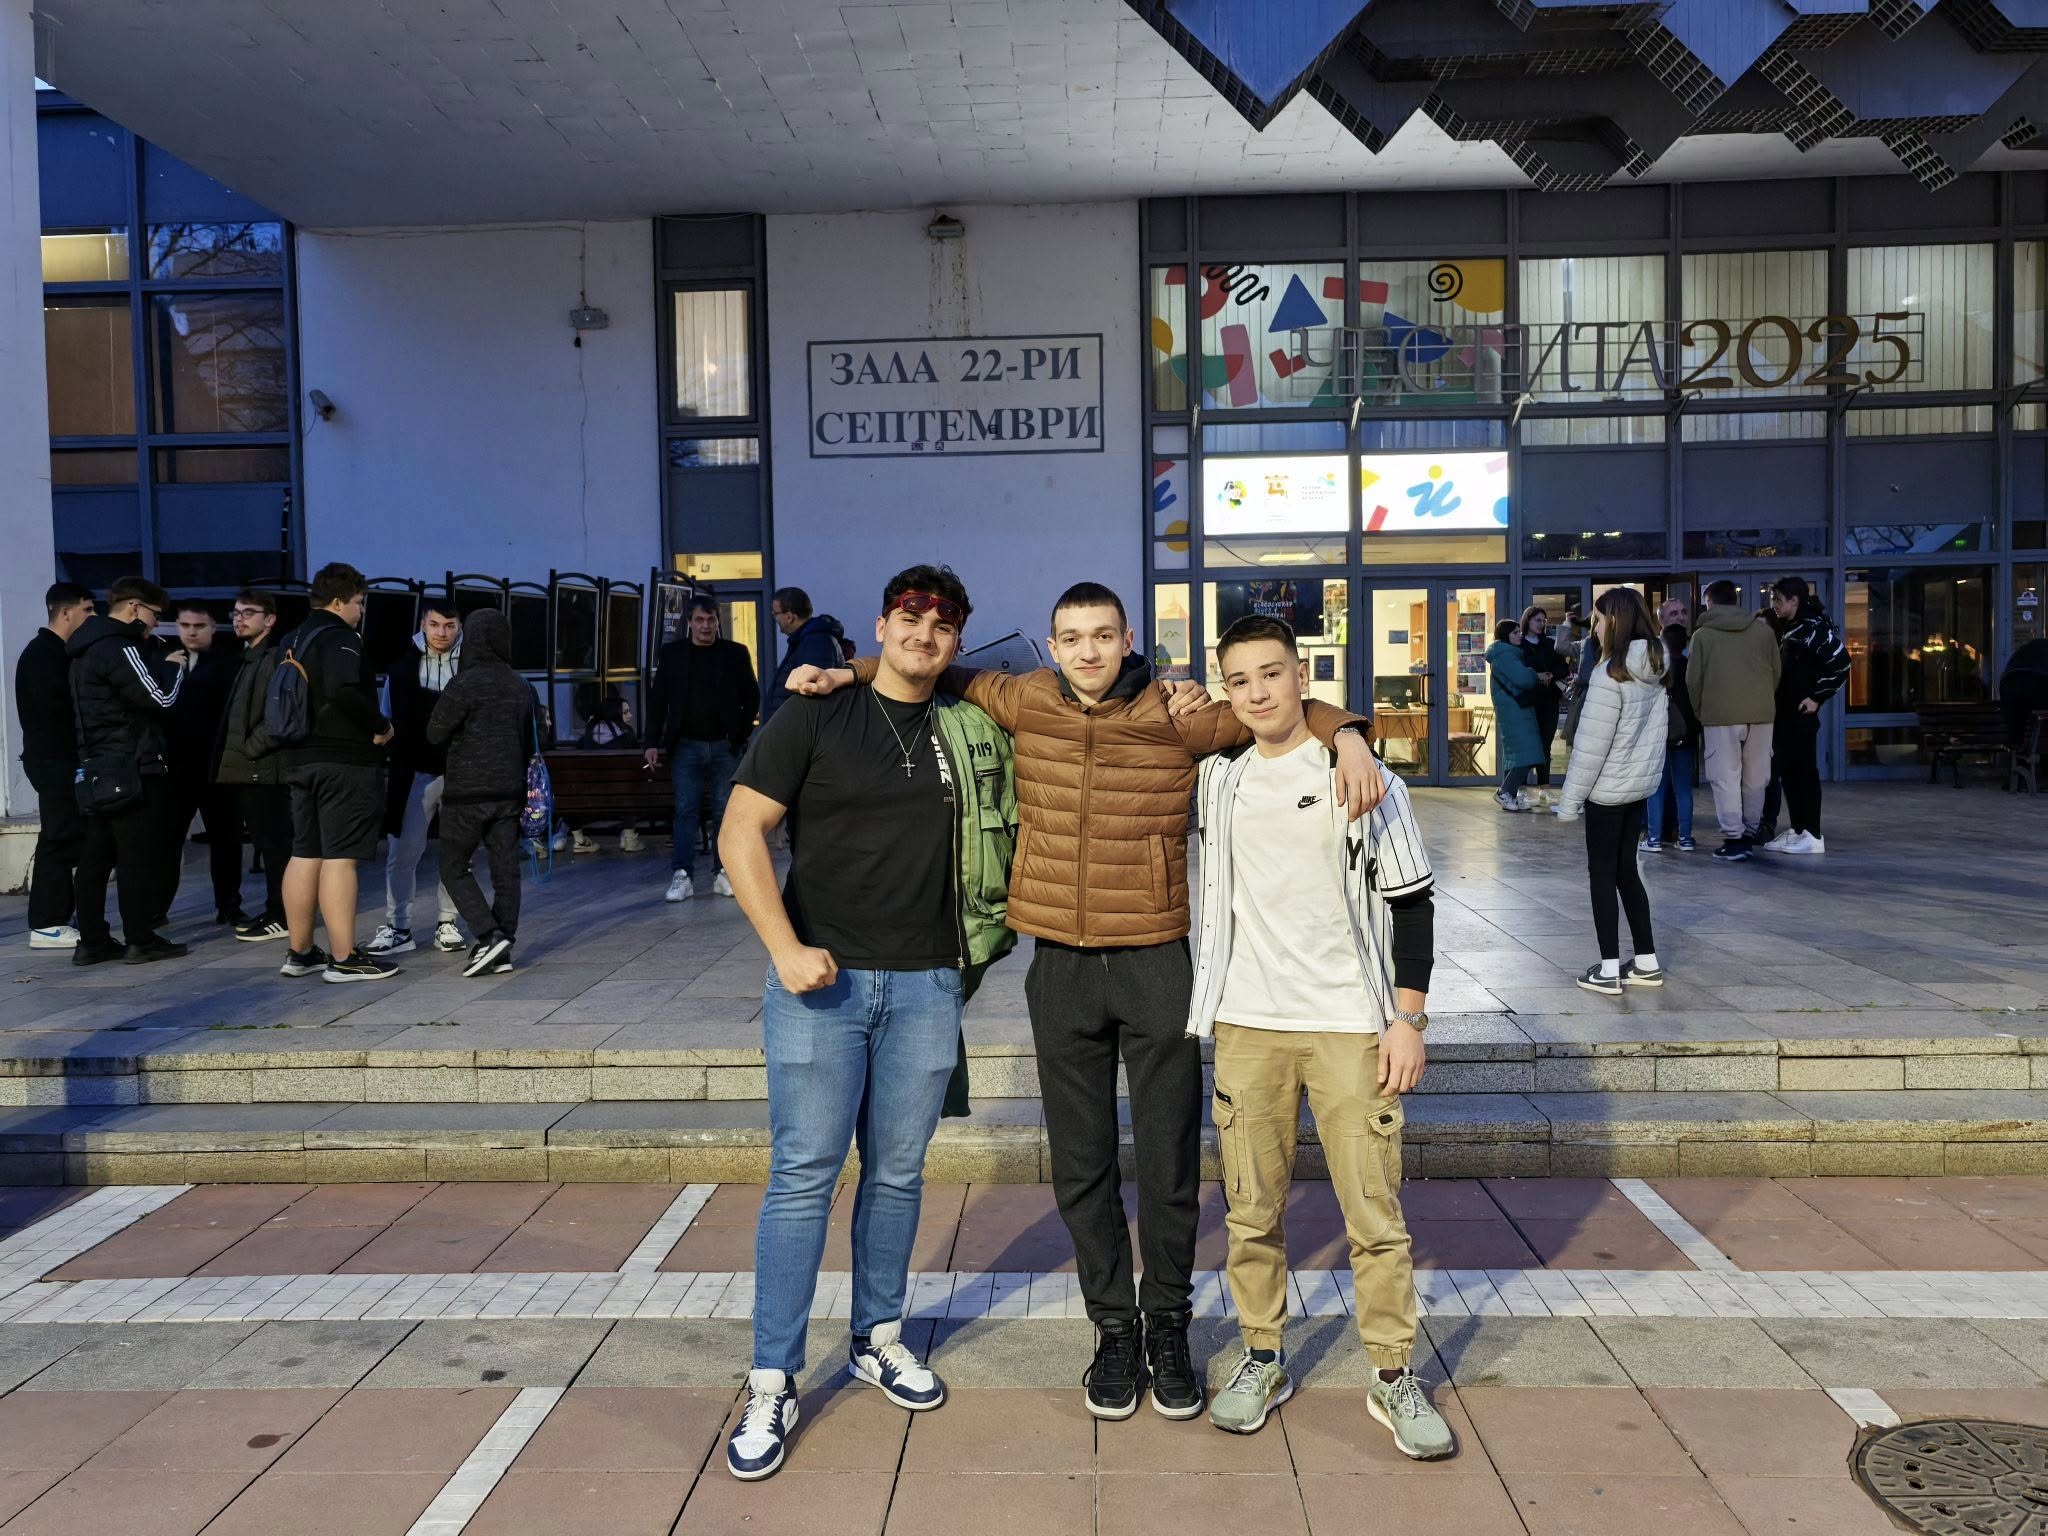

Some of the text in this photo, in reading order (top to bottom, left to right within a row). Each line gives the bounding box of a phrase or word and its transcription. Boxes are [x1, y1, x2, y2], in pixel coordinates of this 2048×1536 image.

[829, 347, 1081, 386] ЗАЛА 22-РИ
[1677, 311, 1910, 389] 2025
[815, 406, 1099, 445] СЕПТЕМВРИ
[1301, 795, 1317, 804] NIKE
